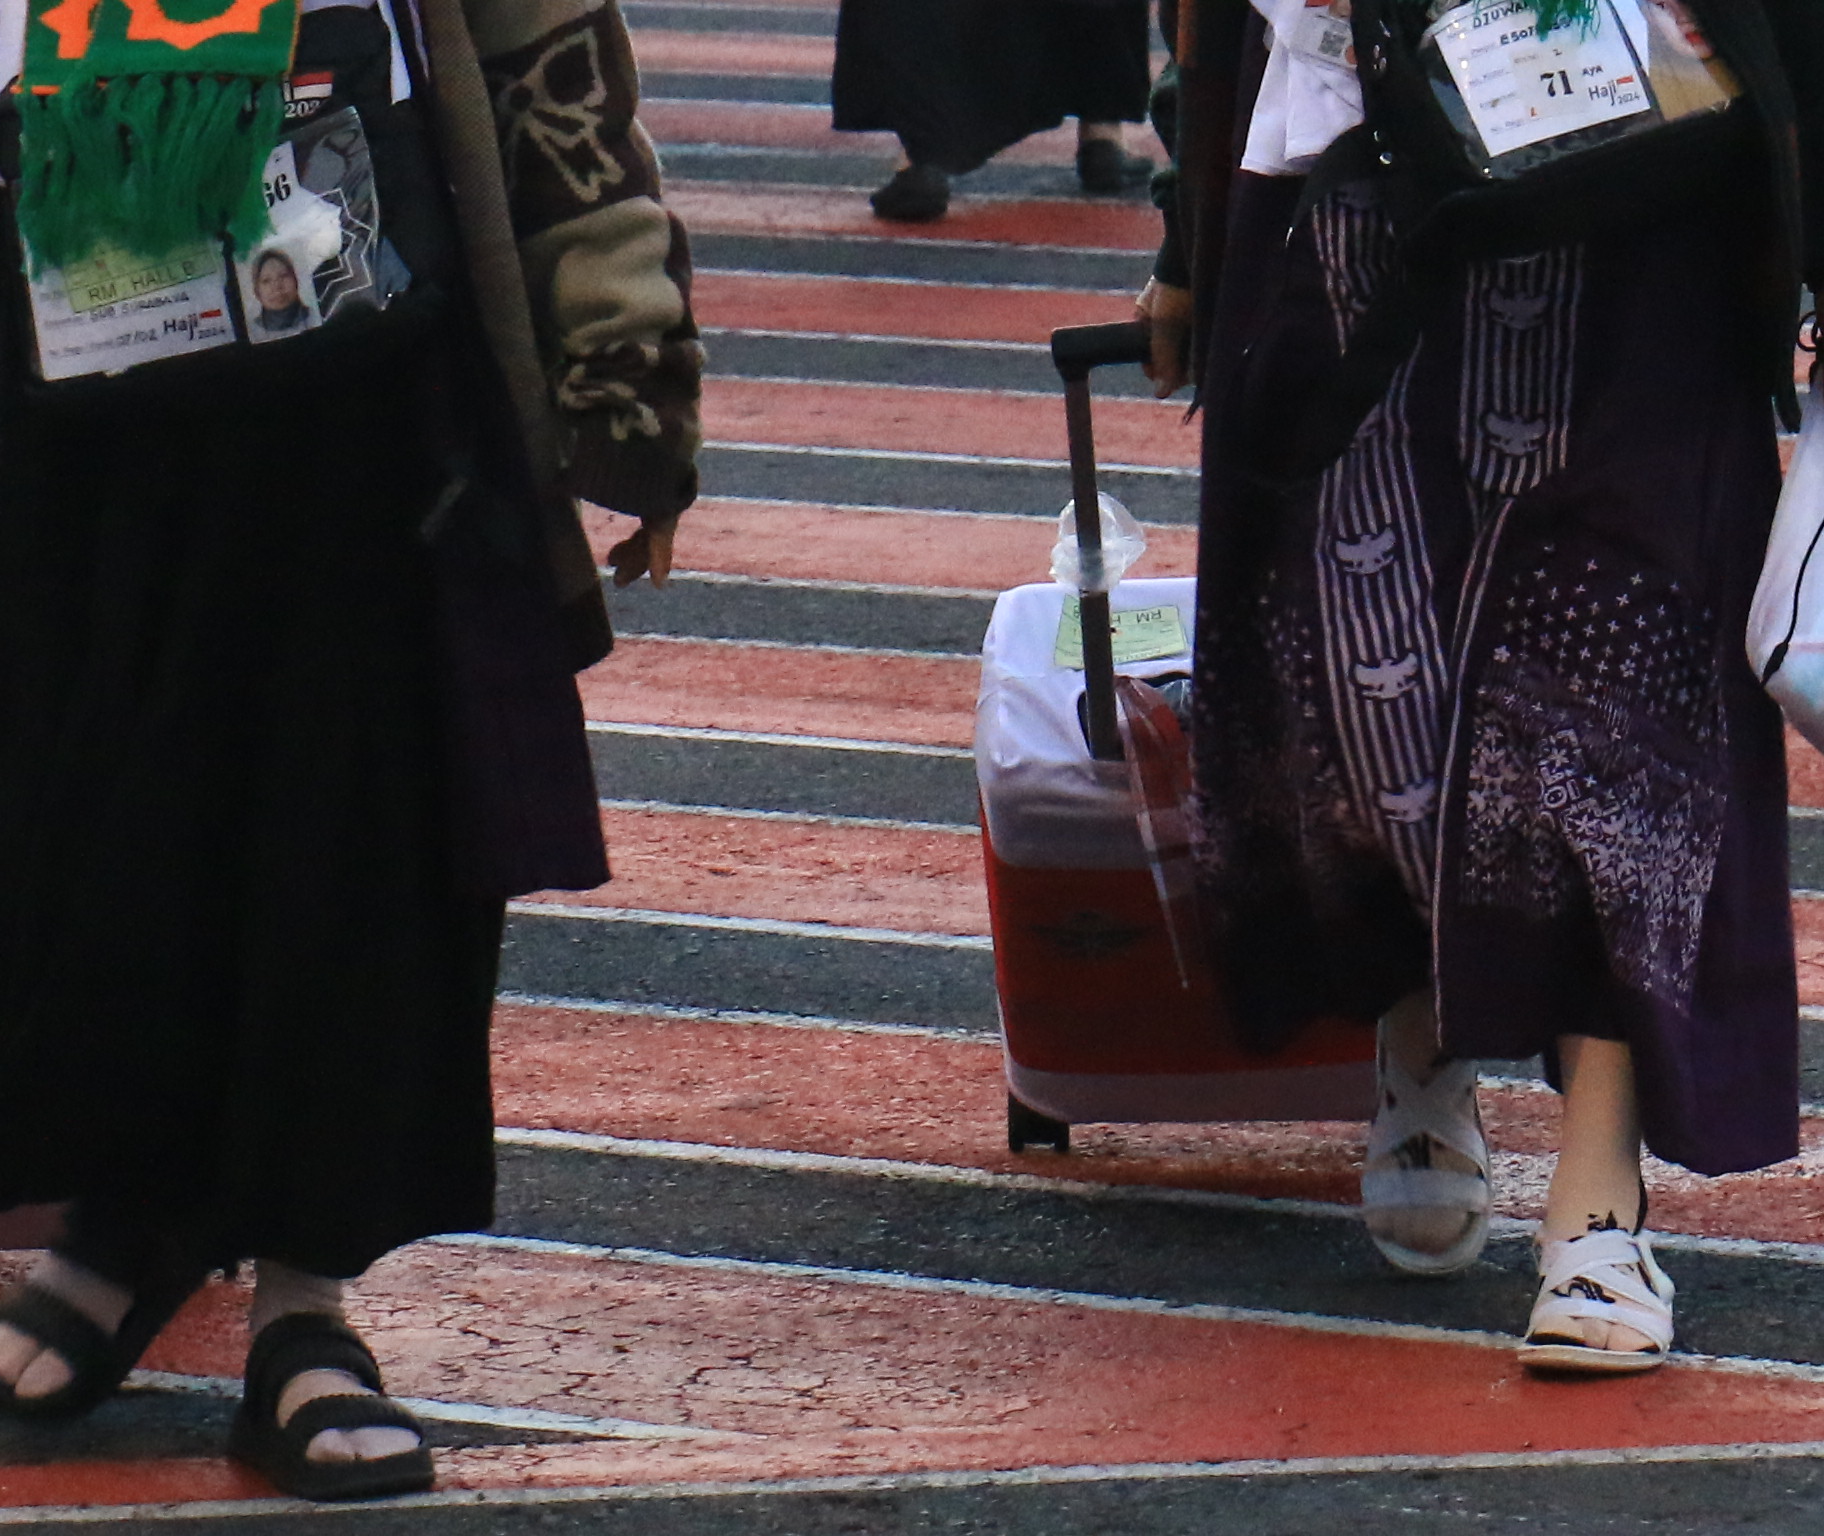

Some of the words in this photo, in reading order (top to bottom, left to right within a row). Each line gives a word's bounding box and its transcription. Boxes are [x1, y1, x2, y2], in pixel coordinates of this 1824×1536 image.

[1539, 69, 1575, 98] 71
[1587, 79, 1617, 107] Haji
[87, 283, 118, 303] RM
[130, 265, 175, 293] HALL
[163, 312, 199, 341] Haji
[1136, 608, 1163, 624] RM
